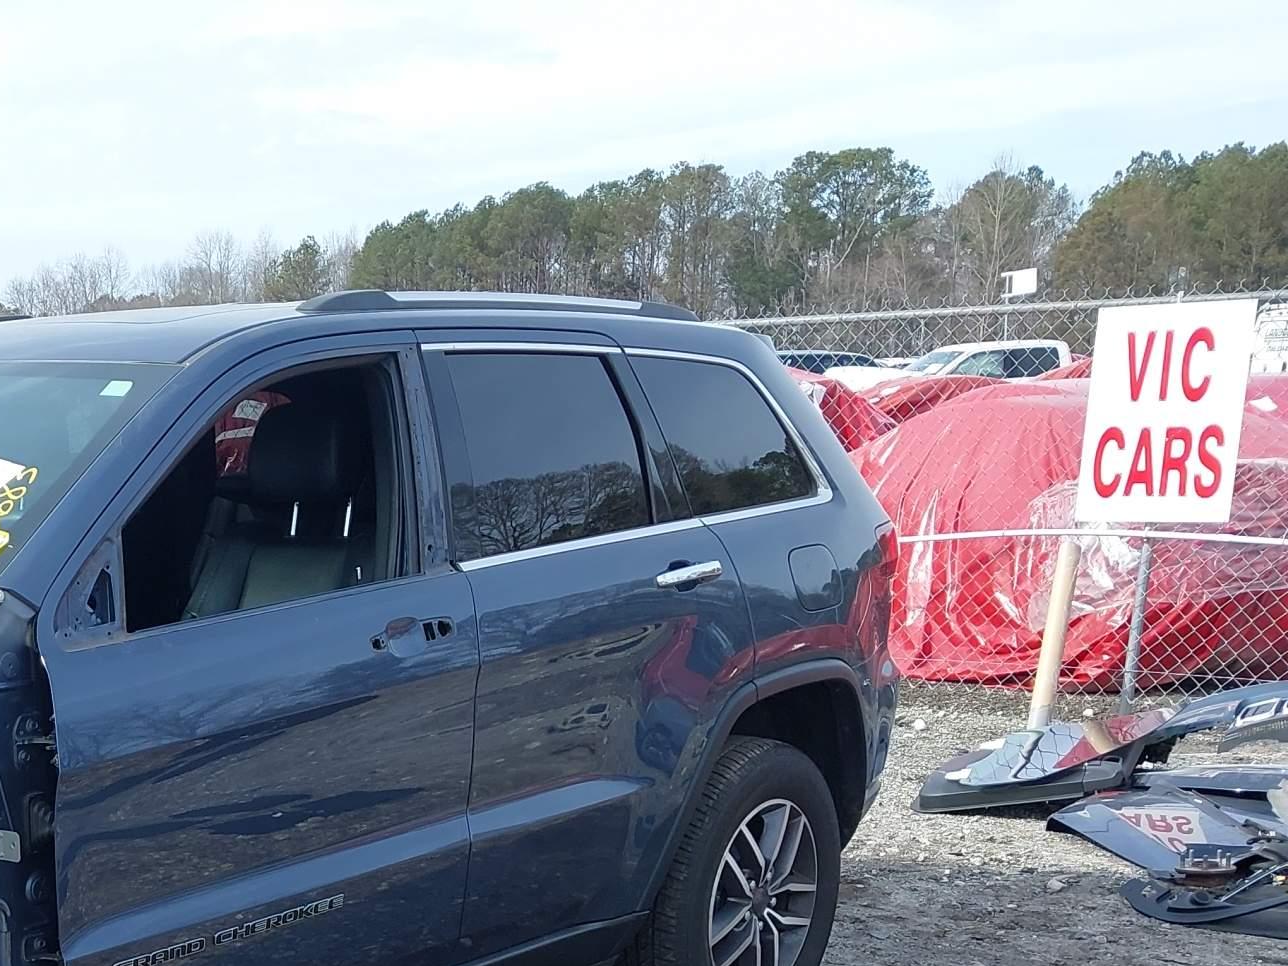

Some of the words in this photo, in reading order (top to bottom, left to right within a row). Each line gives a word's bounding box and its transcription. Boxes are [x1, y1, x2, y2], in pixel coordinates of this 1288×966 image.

[1127, 326, 1216, 402] VIC
[1093, 424, 1225, 498] CARS
[213, 893, 345, 946] CHEROKEE
